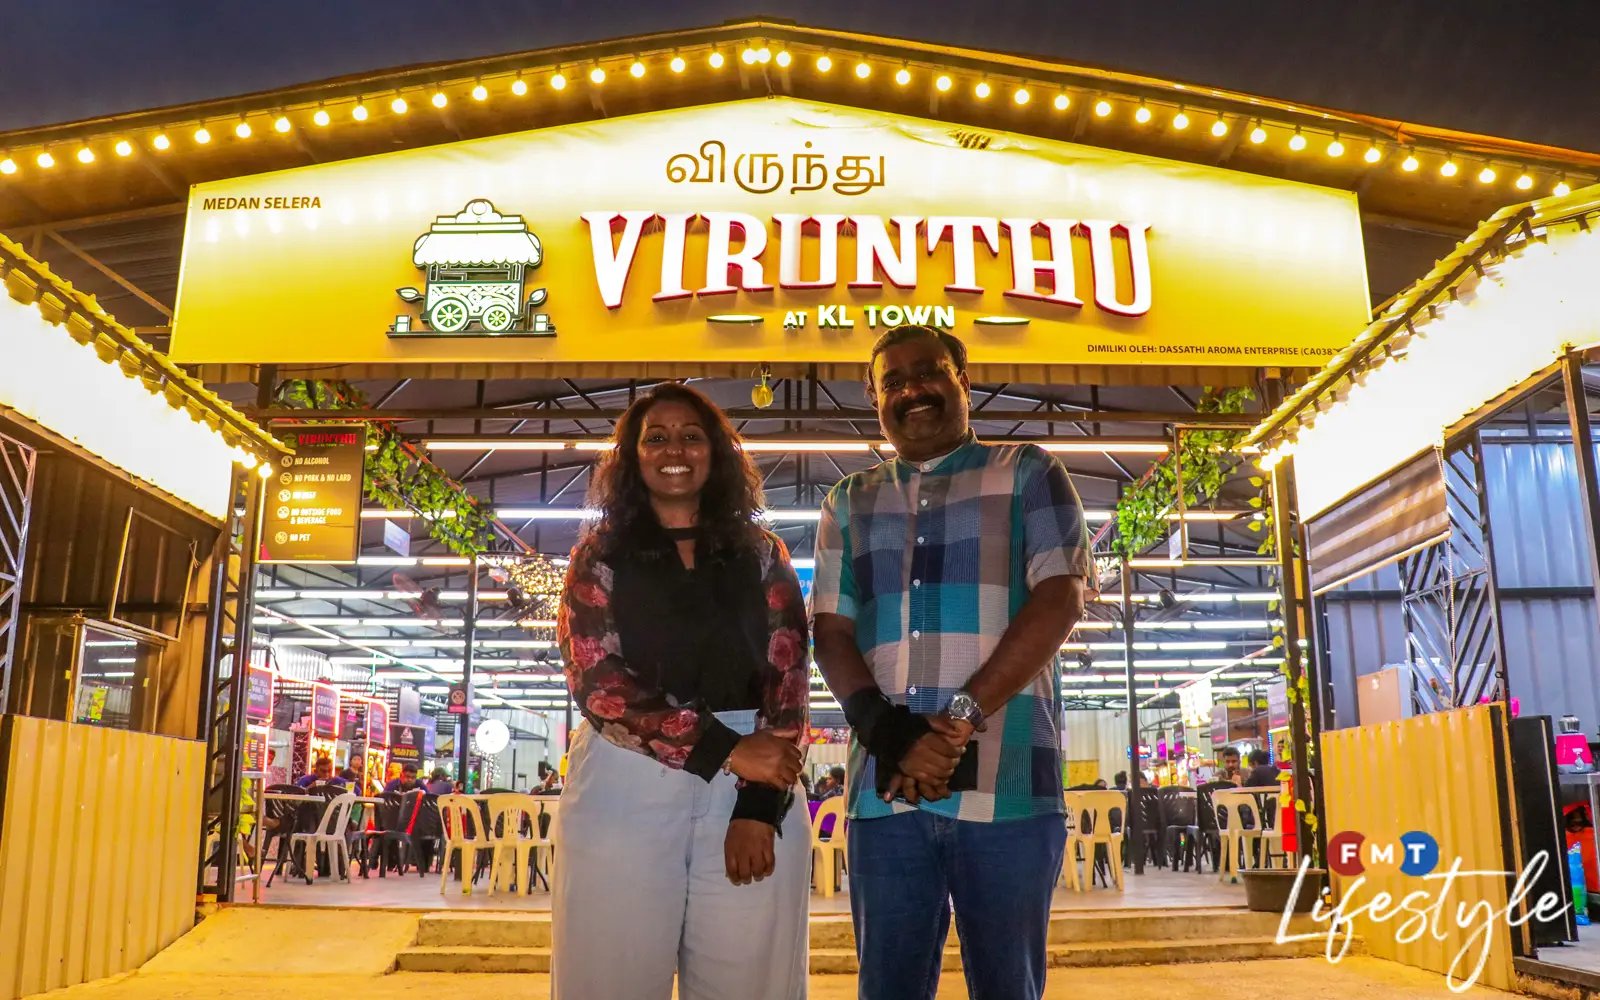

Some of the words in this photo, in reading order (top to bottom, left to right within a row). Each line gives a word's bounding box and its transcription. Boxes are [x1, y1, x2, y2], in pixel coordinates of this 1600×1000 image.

[666, 140, 885, 195] விருந்து
[203, 197, 260, 210] MEDAN
[263, 196, 322, 209] SELERA
[580, 211, 1152, 317] VIRUNTHU
[783, 311, 807, 328] AT
[818, 305, 854, 328] KL
[864, 305, 955, 329] TOWN
[1087, 344, 1127, 353] DIMILIKI
[1129, 345, 1158, 353] OLEH:
[1159, 345, 1205, 354] DASSATHI
[1207, 346, 1243, 355] AROMA
[1244, 346, 1298, 355] ENTERPRISE
[1300, 347, 1334, 356] (CA038
[294, 457, 303, 465] NO
[304, 457, 330, 465] ALCOHOL
[294, 474, 303, 482] NO
[304, 474, 319, 482] PORK
[327, 474, 335, 482] NO
[336, 473, 352, 482] LARD
[296, 516, 326, 525] BEVERAGE
[299, 533, 311, 542] PET
